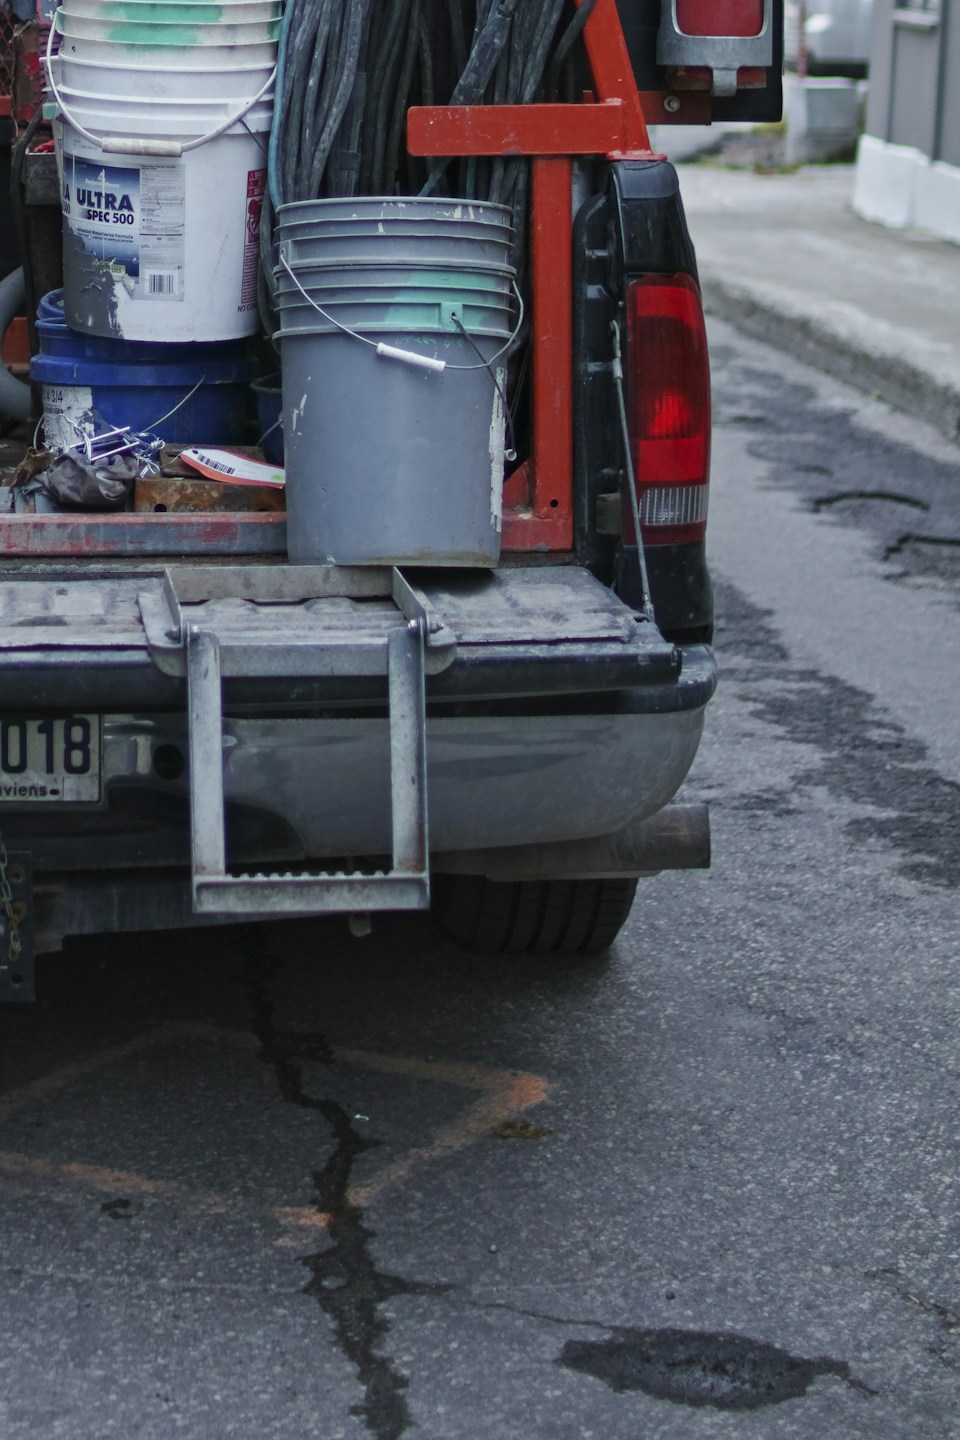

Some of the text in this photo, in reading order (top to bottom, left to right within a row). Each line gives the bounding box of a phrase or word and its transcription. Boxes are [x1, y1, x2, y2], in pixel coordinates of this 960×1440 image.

[76, 186, 135, 212] ULTRA
[87, 209, 134, 225] SPEC 500
